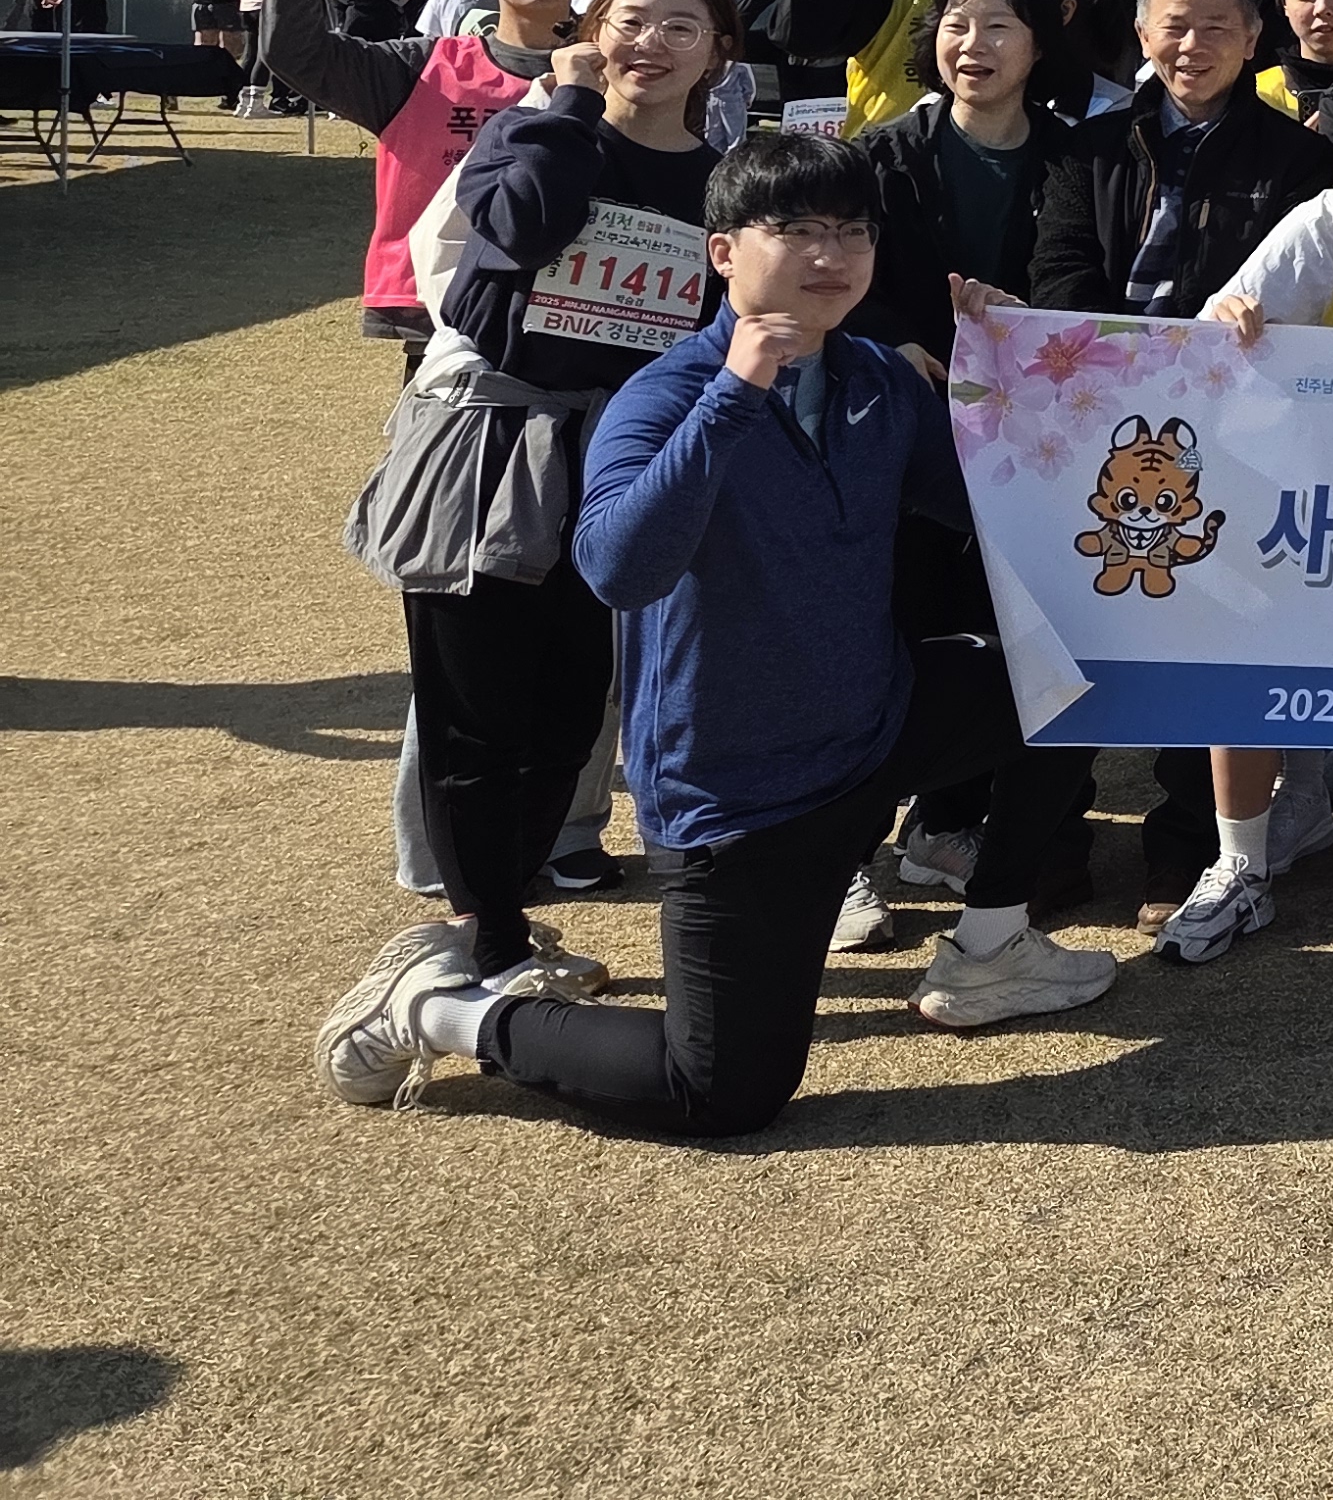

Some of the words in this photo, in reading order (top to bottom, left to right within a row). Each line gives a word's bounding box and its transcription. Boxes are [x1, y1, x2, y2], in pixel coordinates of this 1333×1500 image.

[568, 250, 701, 307] 11414
[534, 294, 561, 308] 2025
[561, 298, 591, 313] JINJU
[591, 302, 641, 321] NAMGANG
[641, 312, 696, 330] MARATHON
[543, 312, 604, 338] BNK
[606, 320, 677, 350] 경남은행
